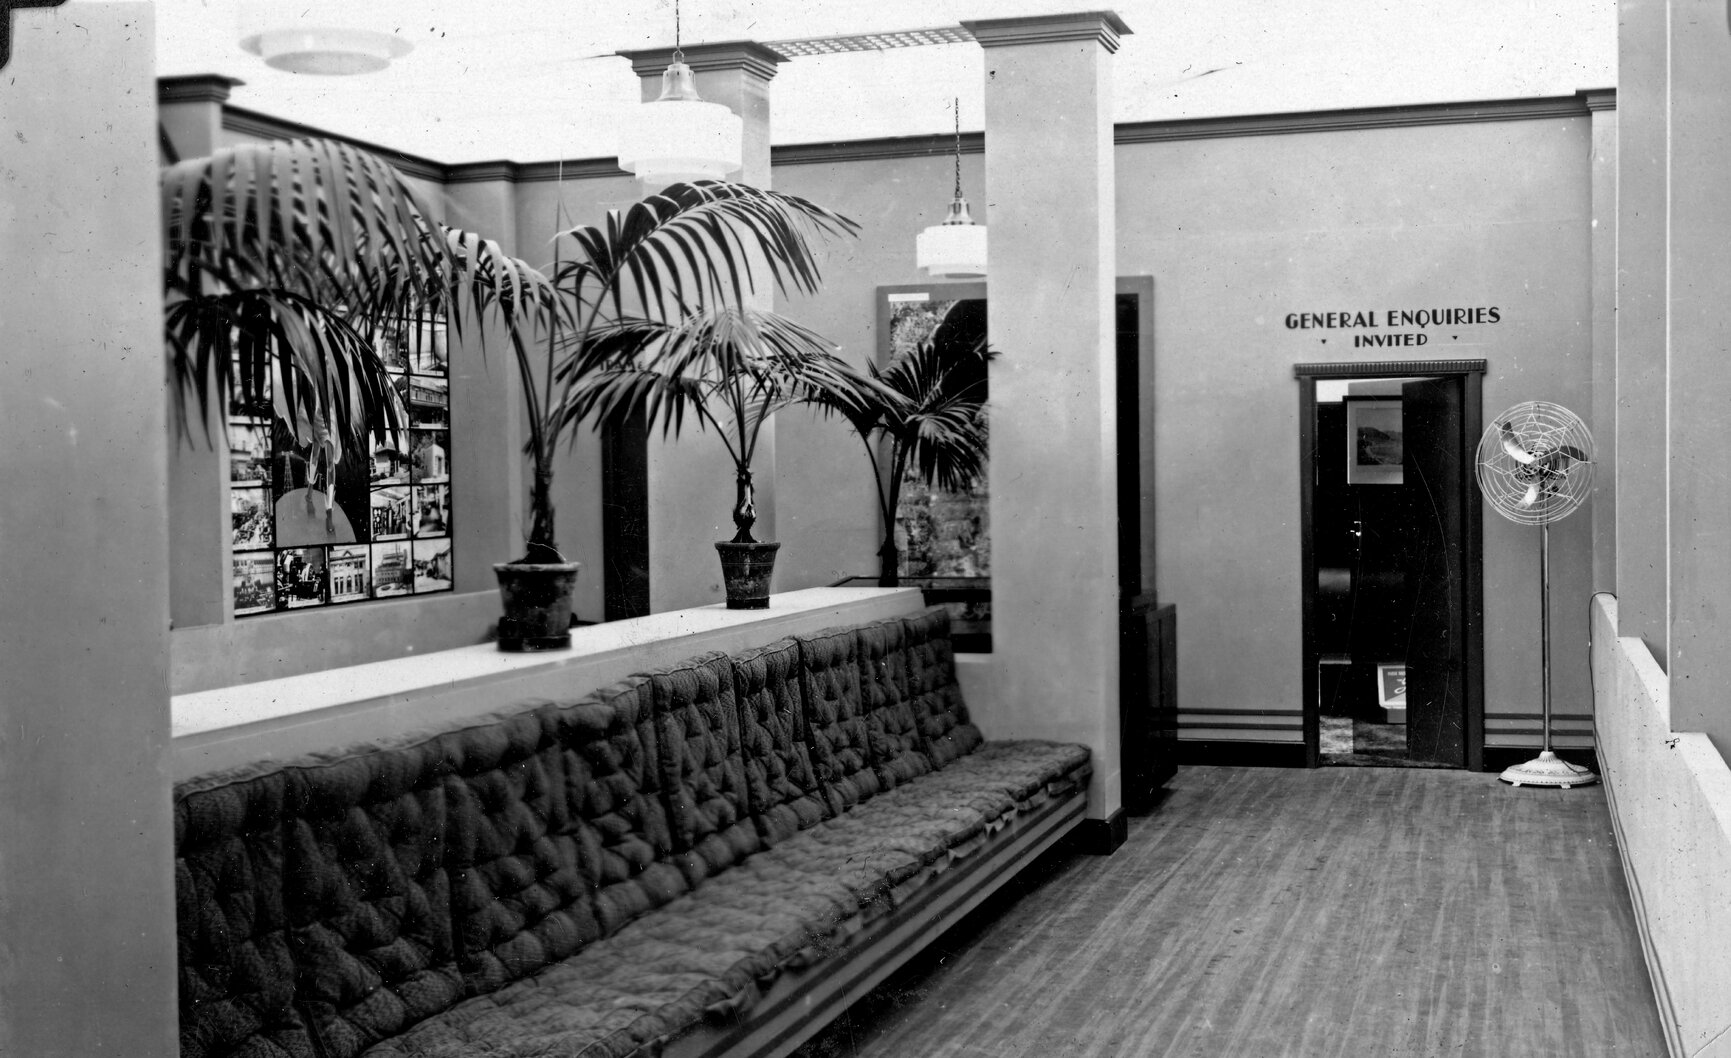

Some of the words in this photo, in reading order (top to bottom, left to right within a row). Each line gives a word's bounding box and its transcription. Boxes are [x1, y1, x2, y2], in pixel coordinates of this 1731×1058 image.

[1285, 311, 1379, 330] GENERAL
[1387, 306, 1501, 329] ENQUIRIES
[1354, 333, 1428, 348] INVITED
